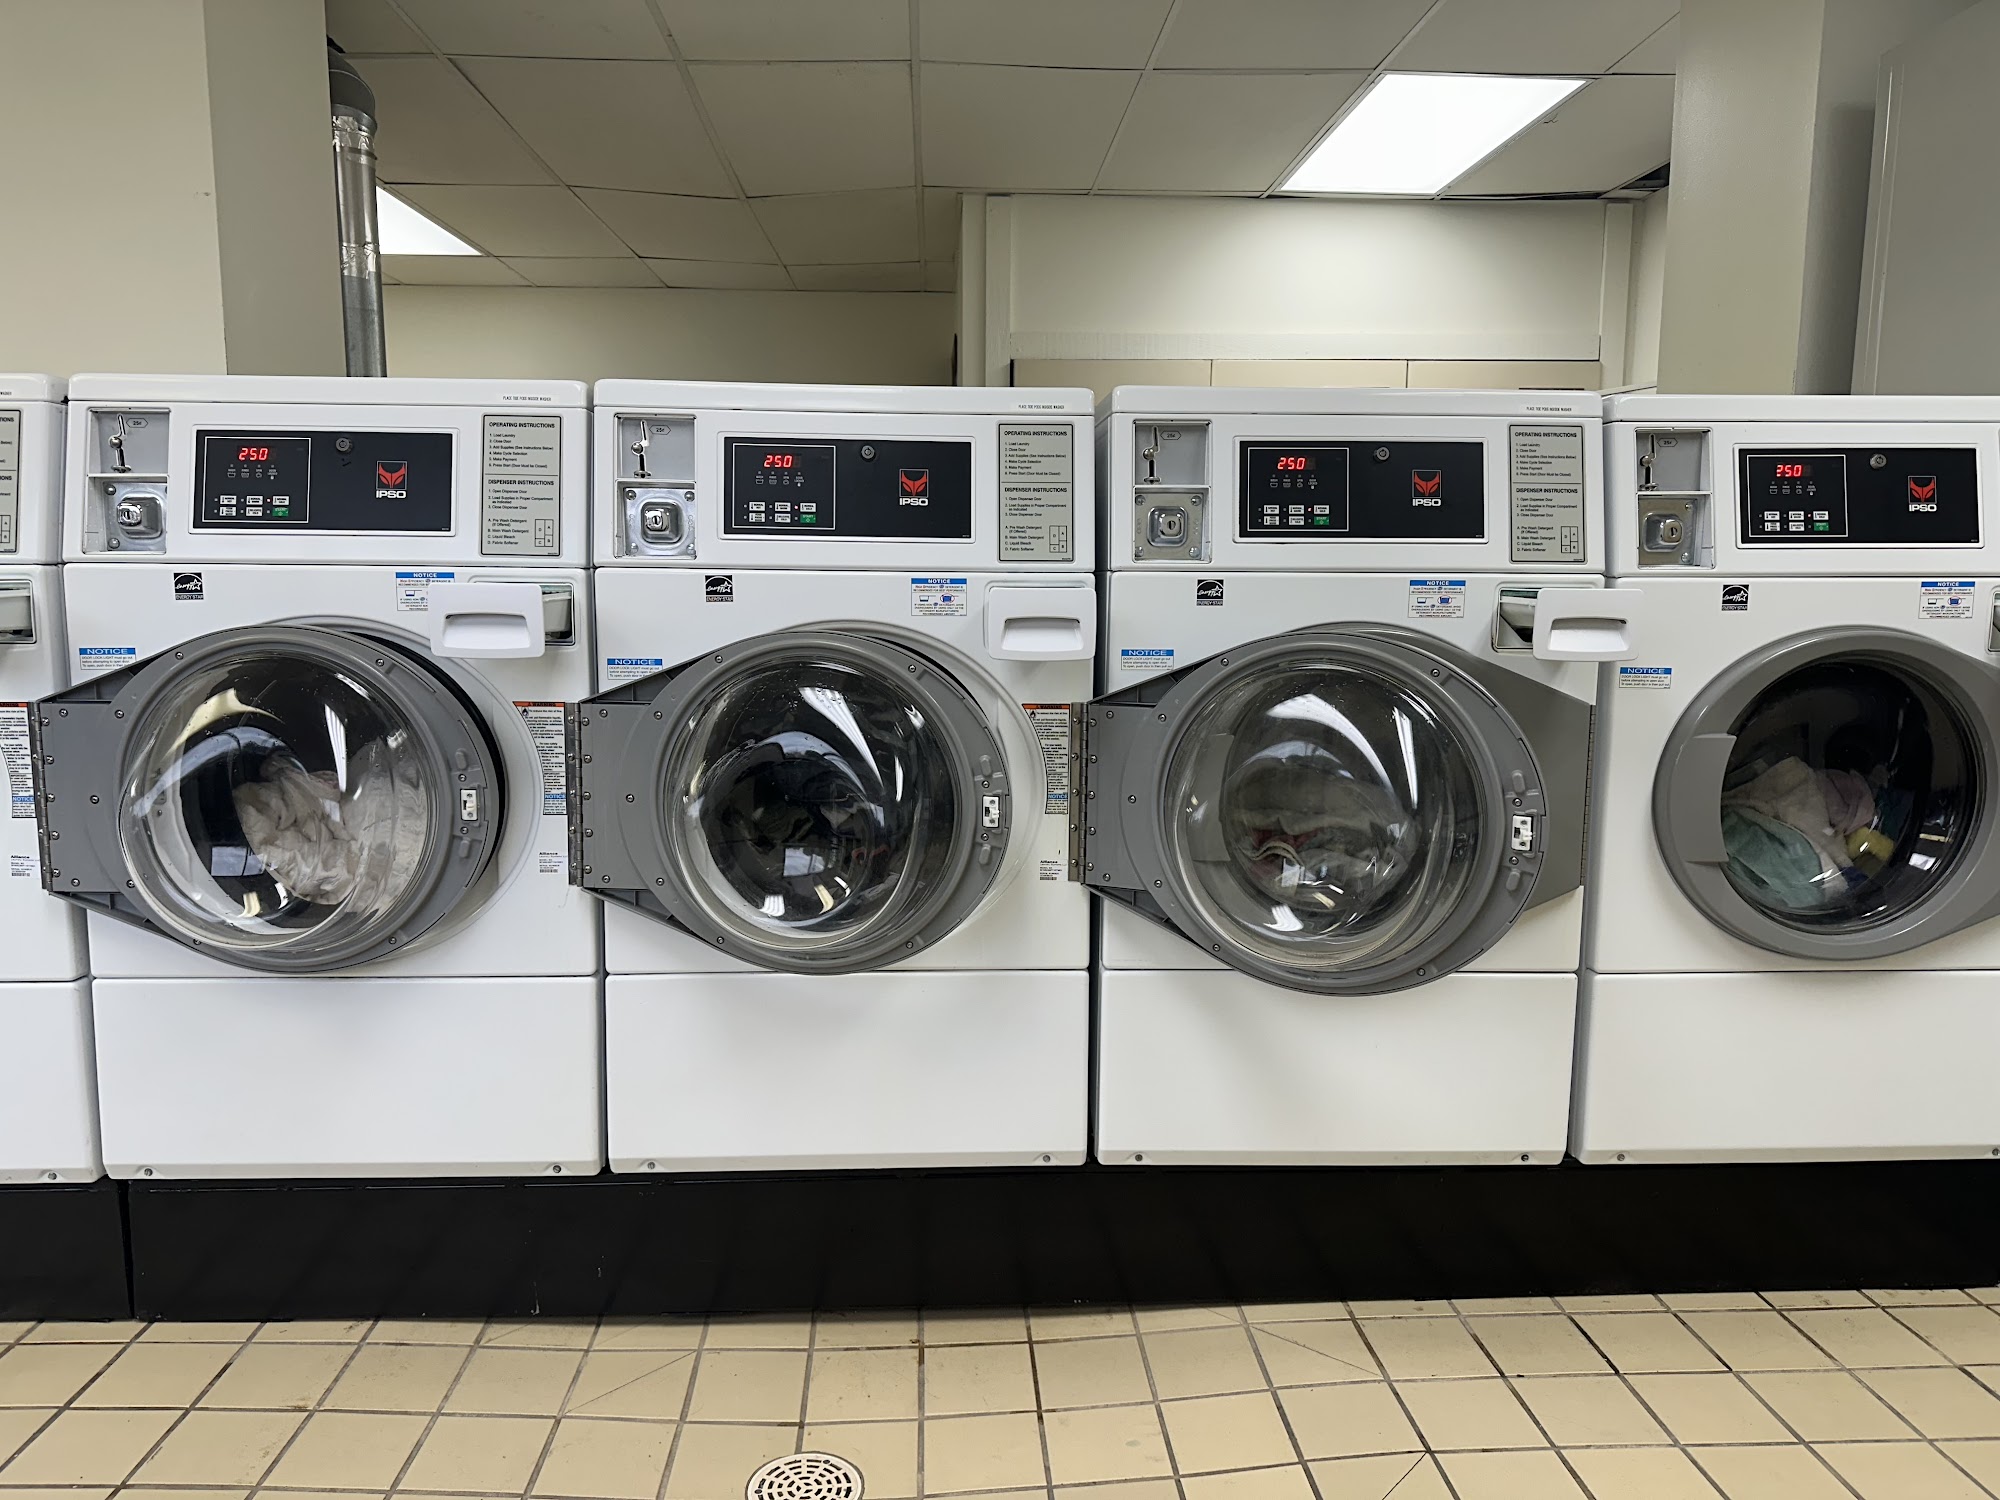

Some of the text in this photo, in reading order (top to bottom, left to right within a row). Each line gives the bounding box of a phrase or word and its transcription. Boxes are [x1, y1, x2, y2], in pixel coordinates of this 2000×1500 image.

[238, 448, 268, 461] 250
[764, 455, 793, 468] 250
[1277, 457, 1306, 470] 250
